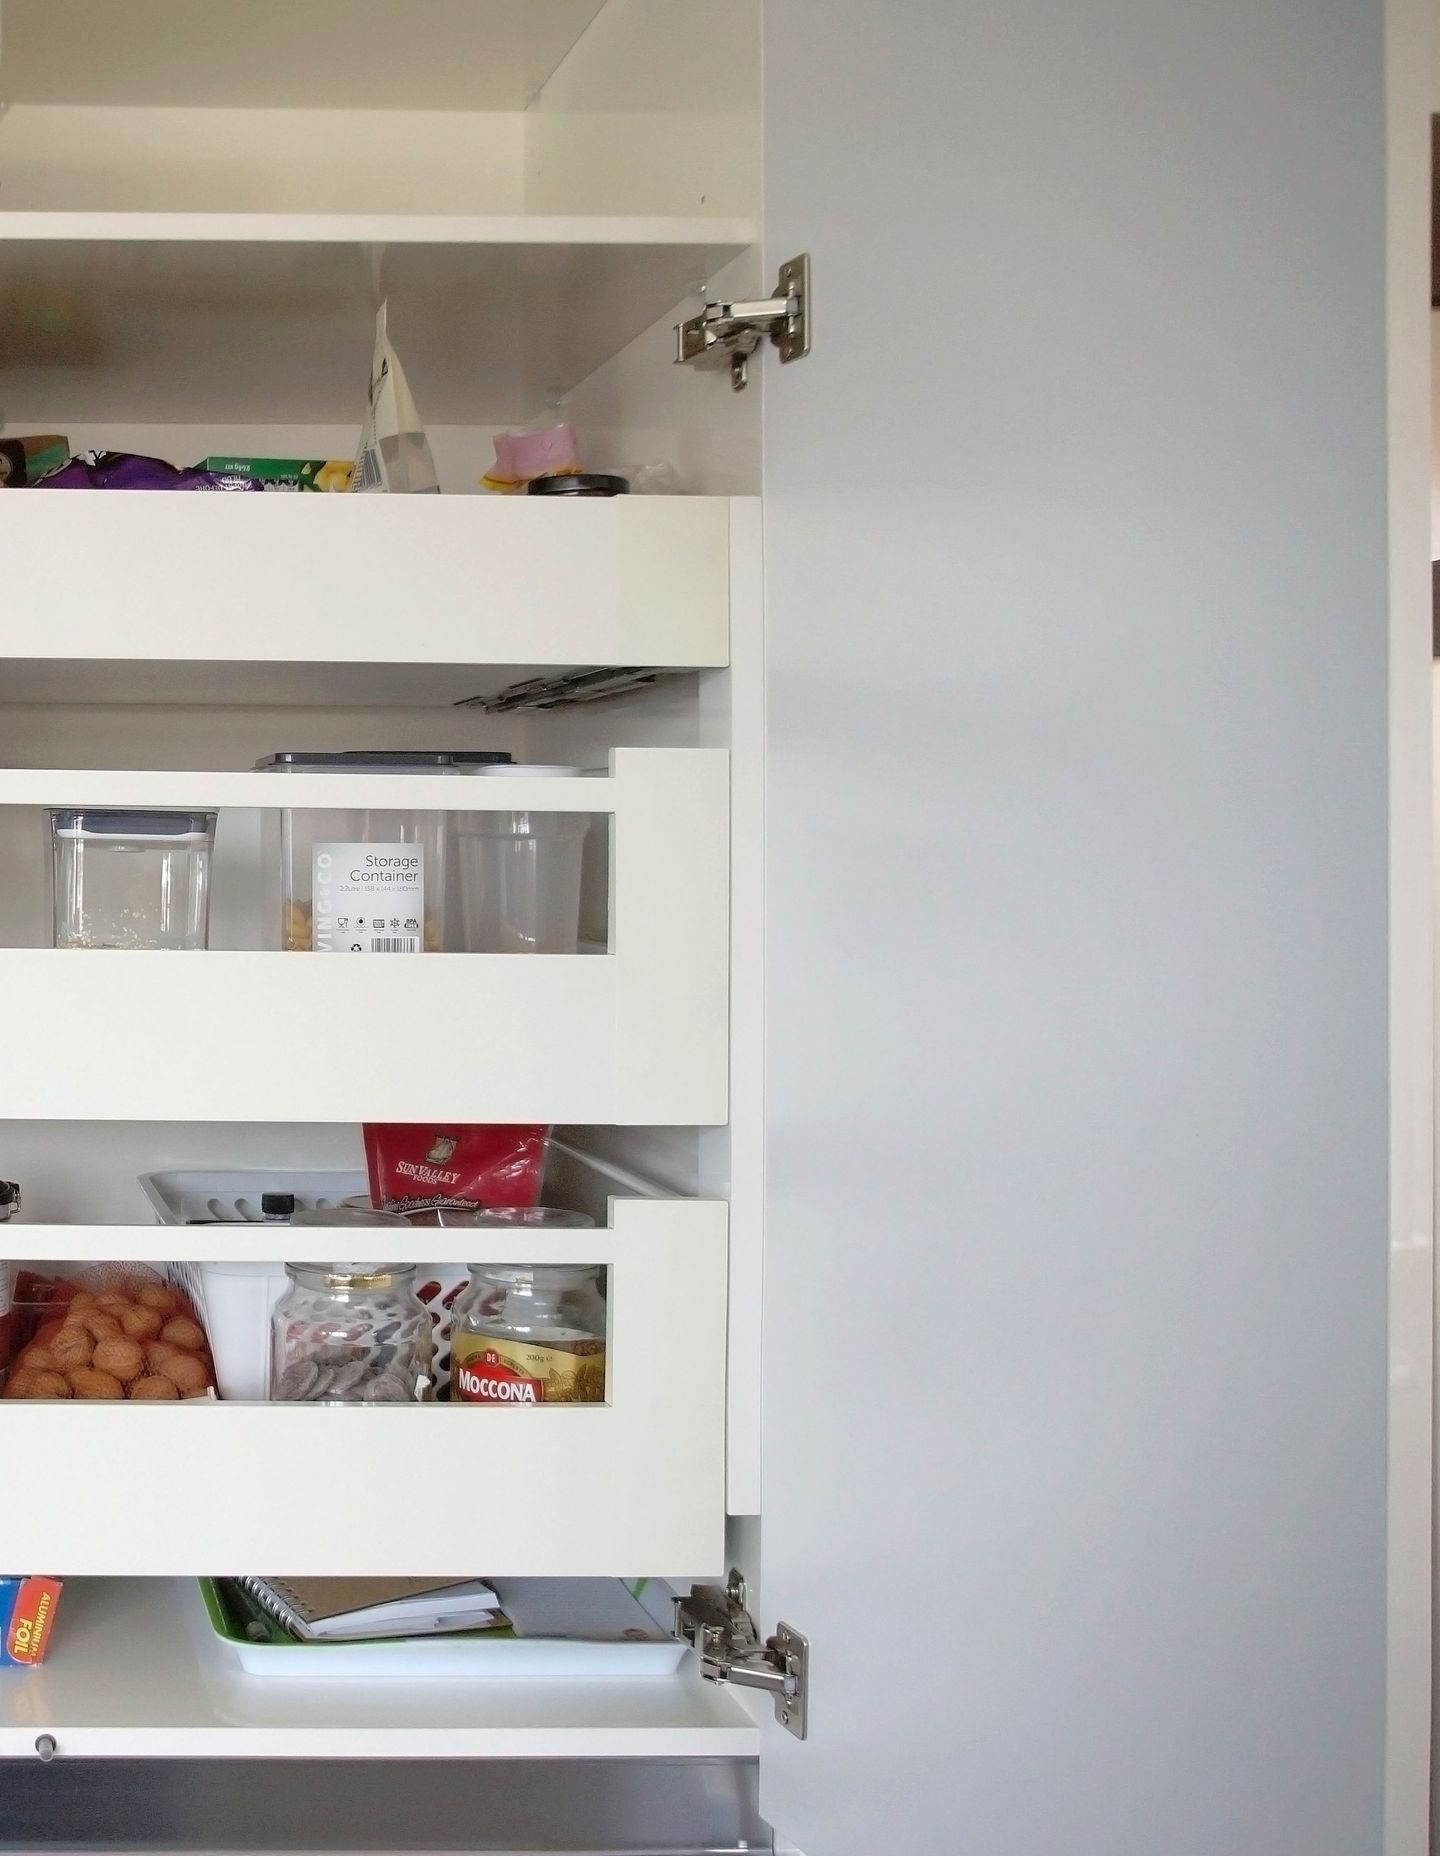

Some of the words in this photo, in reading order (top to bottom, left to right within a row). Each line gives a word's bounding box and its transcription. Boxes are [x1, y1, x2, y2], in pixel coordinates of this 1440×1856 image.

[366, 855, 418, 870] Storage
[350, 869, 418, 882] Container
[396, 1161, 418, 1175] SUN
[419, 1165, 461, 1184] VALLEY
[412, 1175, 438, 1185] FOODS
[486, 1352, 497, 1363] DE
[526, 1354, 544, 1363] 200g
[459, 1367, 537, 1402] MOCCONA
[30, 1591, 51, 1657] ALUMINIUM
[14, 1617, 33, 1654] FOIL
